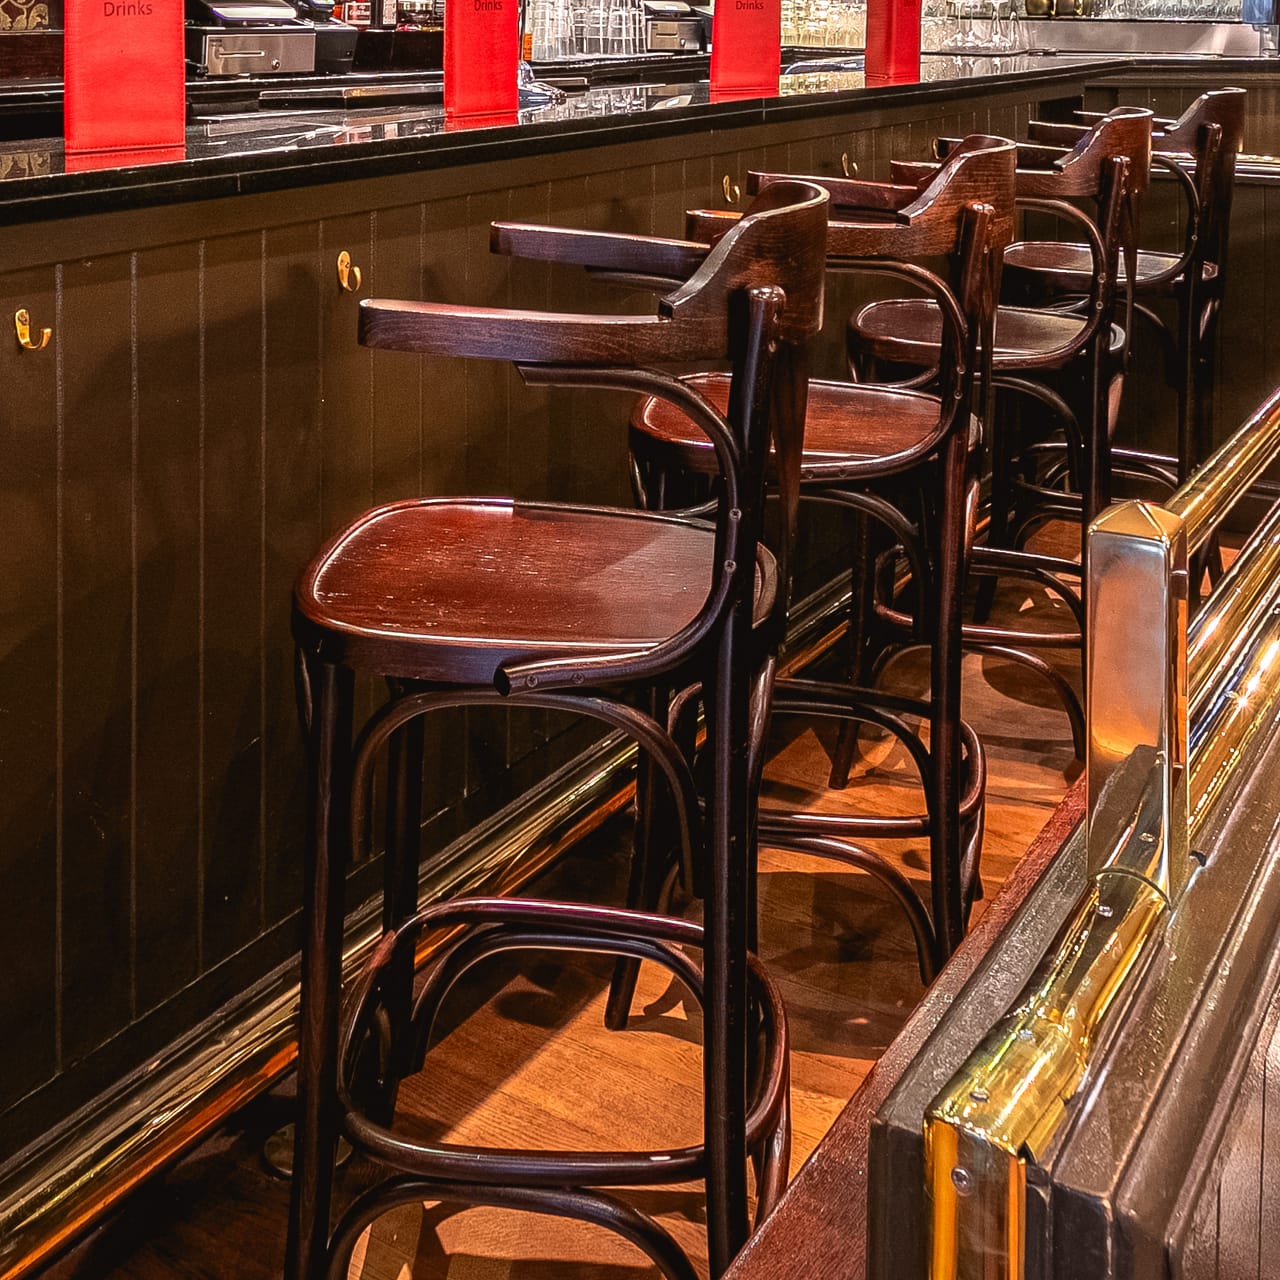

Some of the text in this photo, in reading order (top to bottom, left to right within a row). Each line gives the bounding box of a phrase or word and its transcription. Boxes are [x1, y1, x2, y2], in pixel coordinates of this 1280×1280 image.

[104, 0, 153, 17] Drinks
[474, 0, 503, 12] Drinks
[735, 0, 765, 10] Drinks
